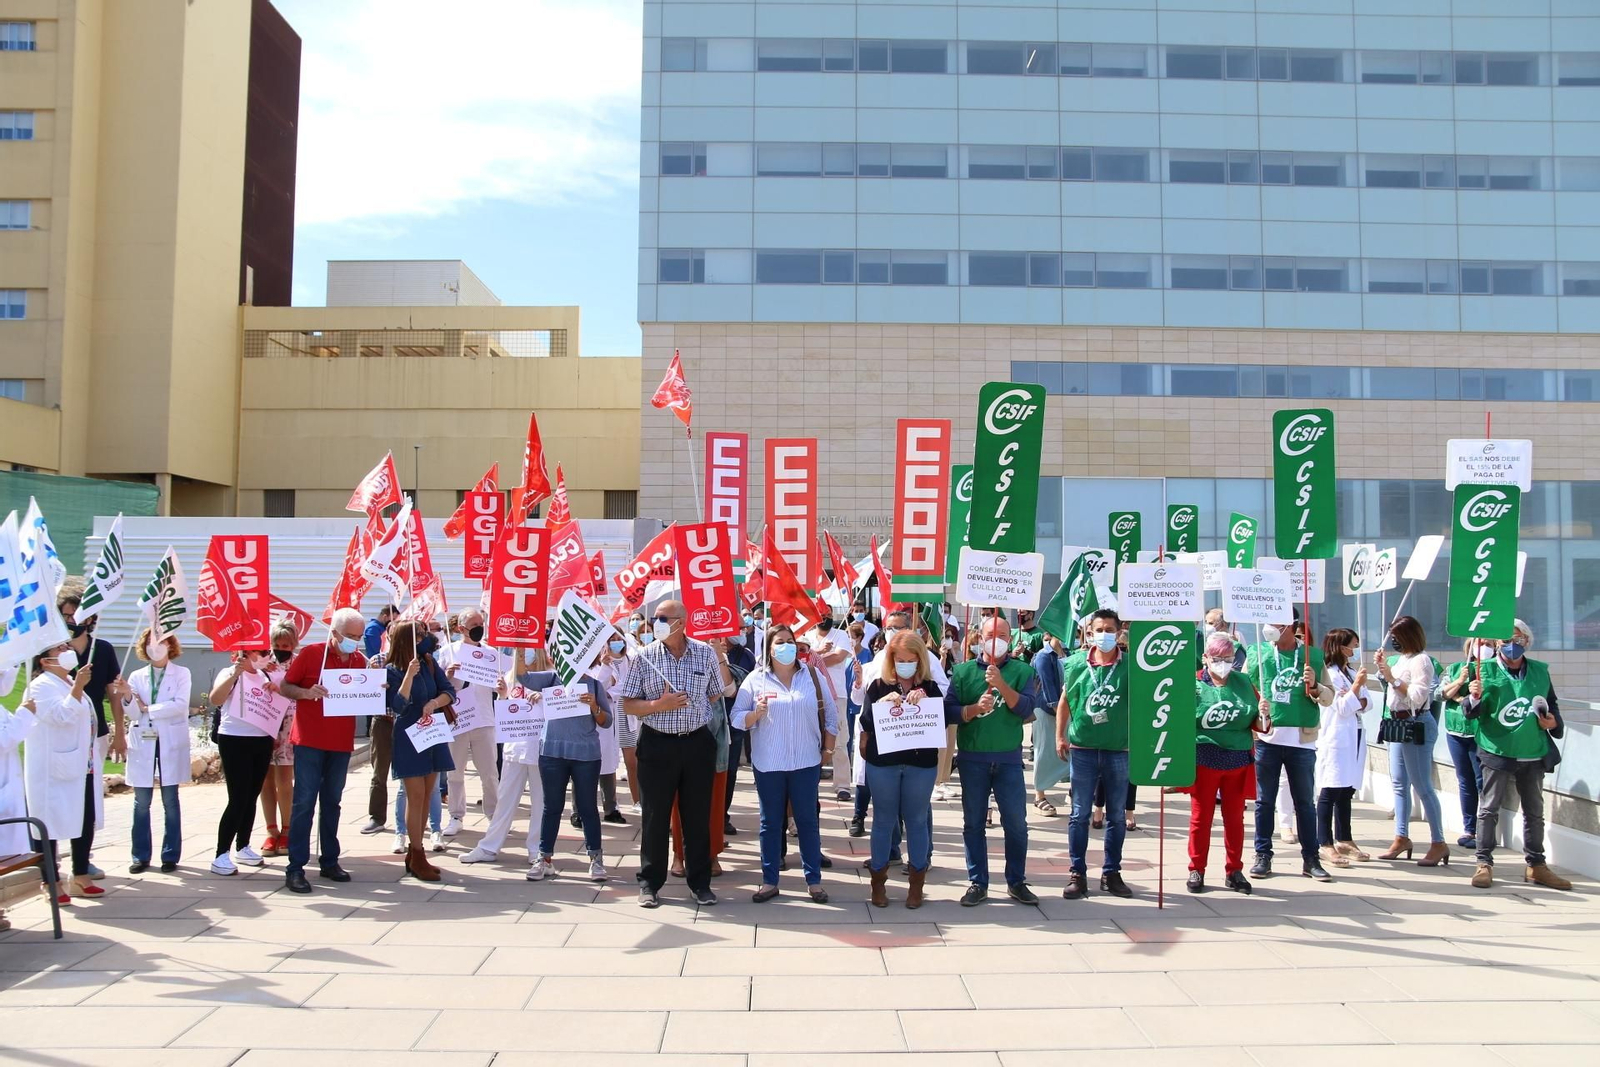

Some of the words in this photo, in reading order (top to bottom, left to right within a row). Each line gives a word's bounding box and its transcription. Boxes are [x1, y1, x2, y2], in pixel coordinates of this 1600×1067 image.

[902, 427, 942, 570] CCOO
[472, 496, 498, 554] UGT
[504, 532, 540, 612] UGT
[686, 528, 724, 606] UGT
[967, 574, 1018, 584] DEVUELVENOS
[1006, 586, 1016, 594] DE
[1232, 594, 1274, 602] DEVUELVENOS
[556, 603, 596, 655] SMA
[882, 724, 909, 732] MOMENTO
